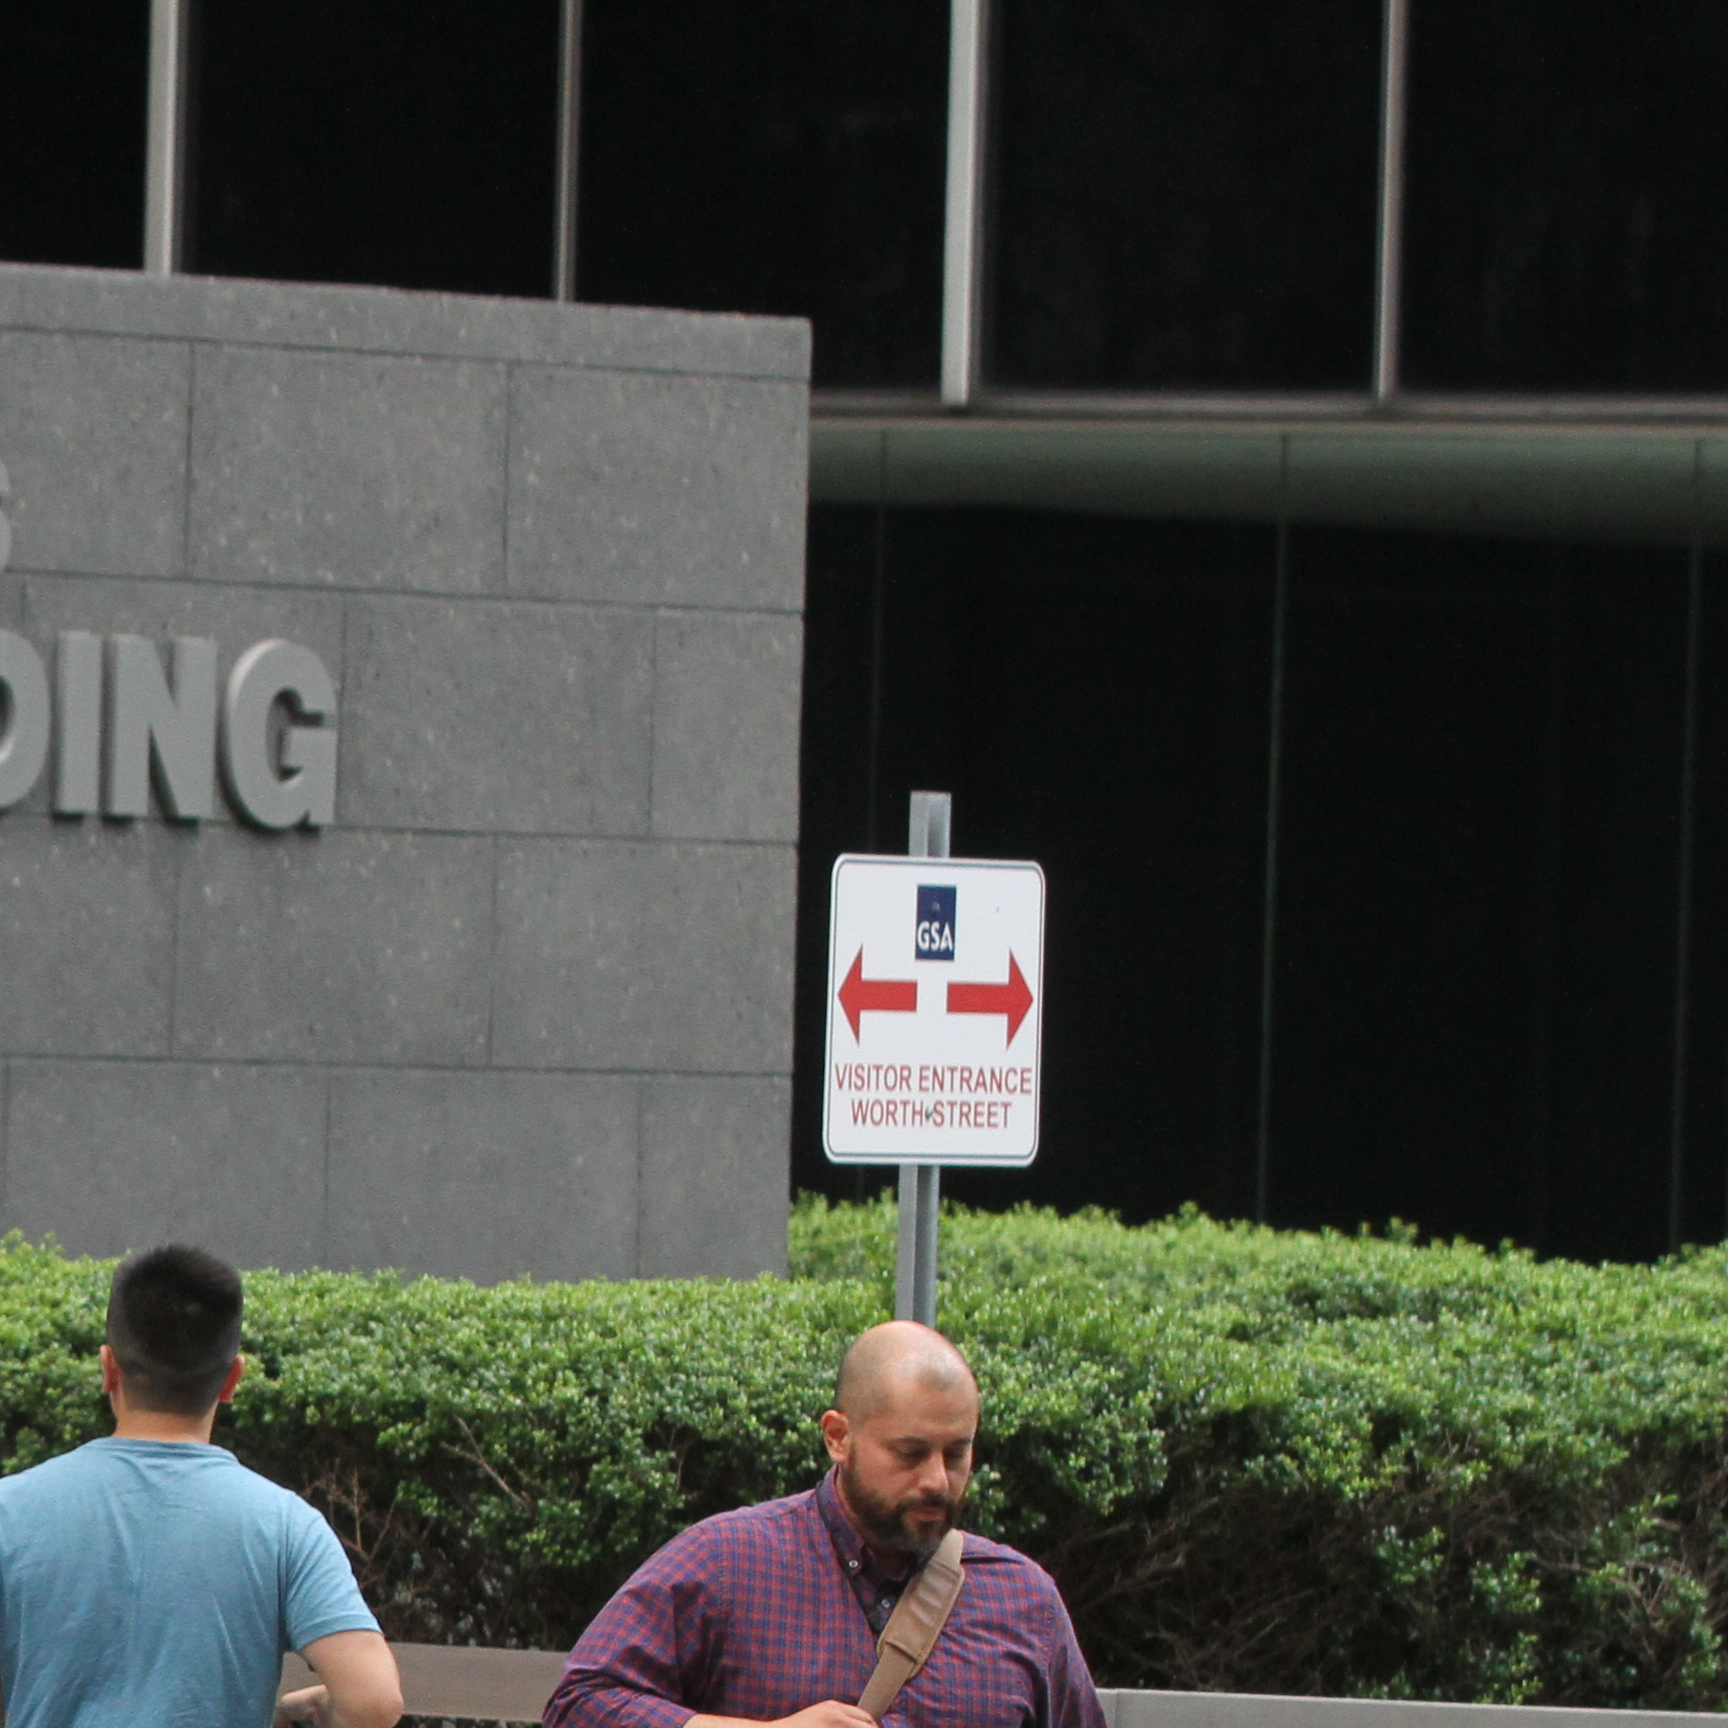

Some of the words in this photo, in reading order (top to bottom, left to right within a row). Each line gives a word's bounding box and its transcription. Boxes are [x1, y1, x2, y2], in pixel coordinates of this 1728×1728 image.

[917, 920, 953, 952] GSA
[834, 1063, 912, 1092] VISITOR
[918, 1065, 1033, 1095] ENTRANCE
[850, 1099, 925, 1128] WORTH
[932, 1101, 1012, 1130] STREET
